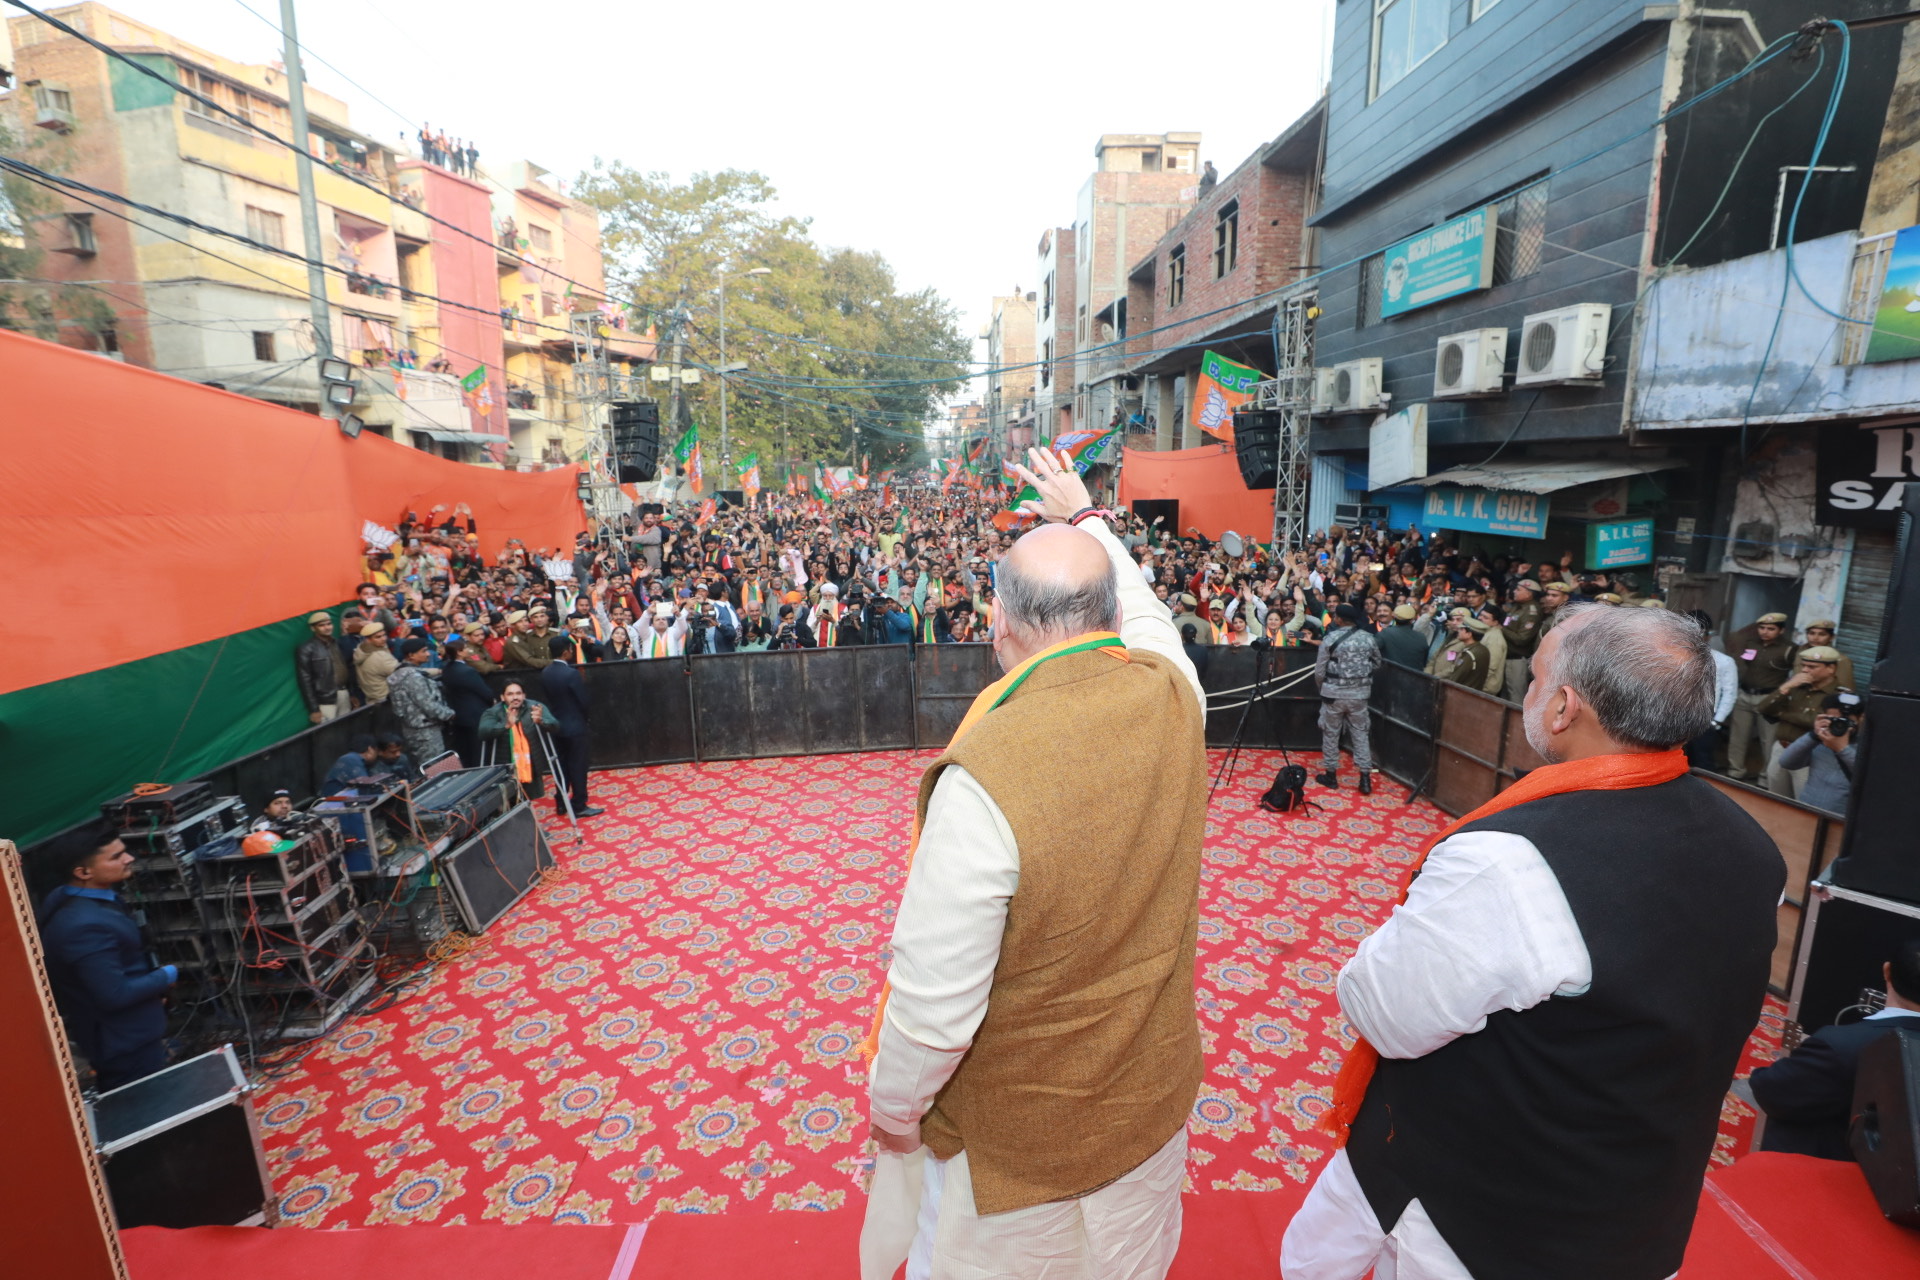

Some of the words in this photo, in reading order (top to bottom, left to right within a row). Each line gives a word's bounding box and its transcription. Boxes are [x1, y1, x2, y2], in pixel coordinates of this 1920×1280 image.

[1453, 492, 1467, 518] V.
[1472, 493, 1489, 520] K.
[1496, 494, 1539, 524] GOEL
